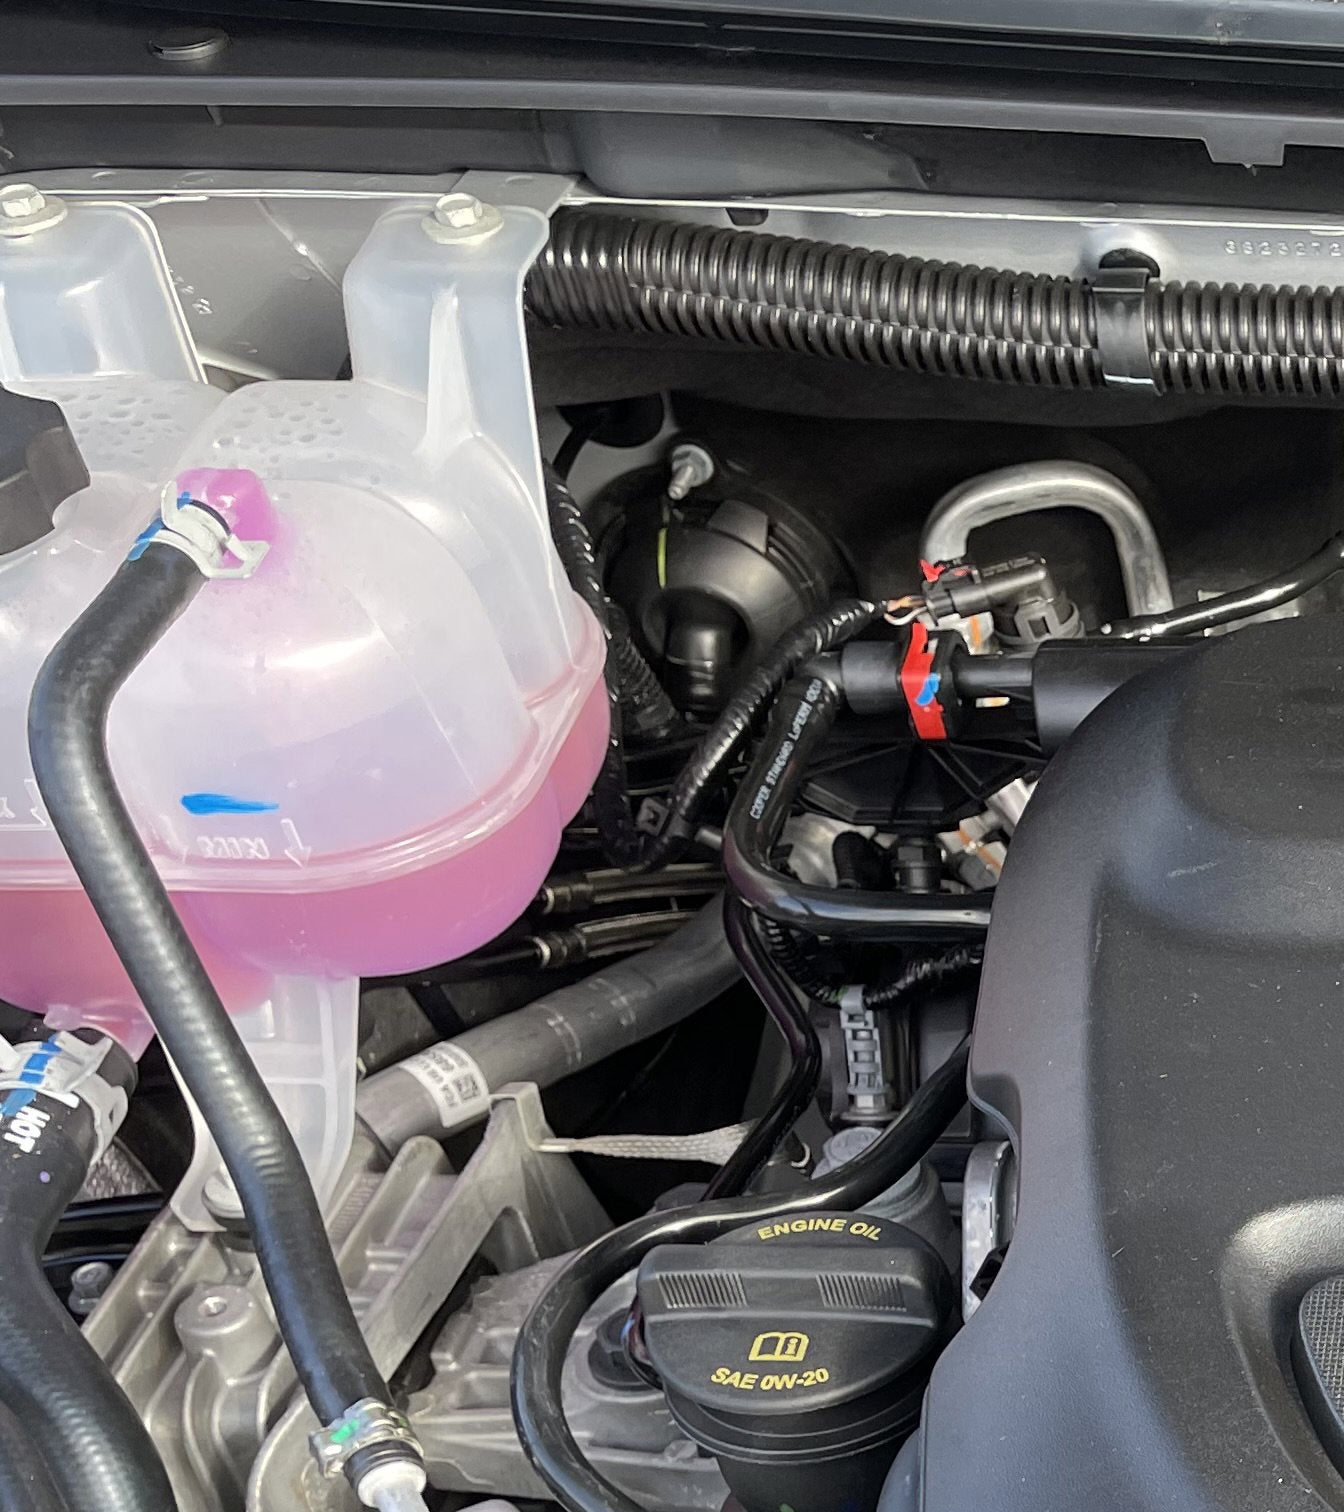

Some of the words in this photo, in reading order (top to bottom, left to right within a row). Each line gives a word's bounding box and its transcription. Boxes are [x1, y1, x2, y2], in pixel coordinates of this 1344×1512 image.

[3, 1105, 50, 1153] HOT
[758, 1219, 847, 1240] ENGINE
[849, 1222, 881, 1241] OIL
[711, 1367, 759, 1390] SAE
[760, 1368, 830, 1391] 0W-20
